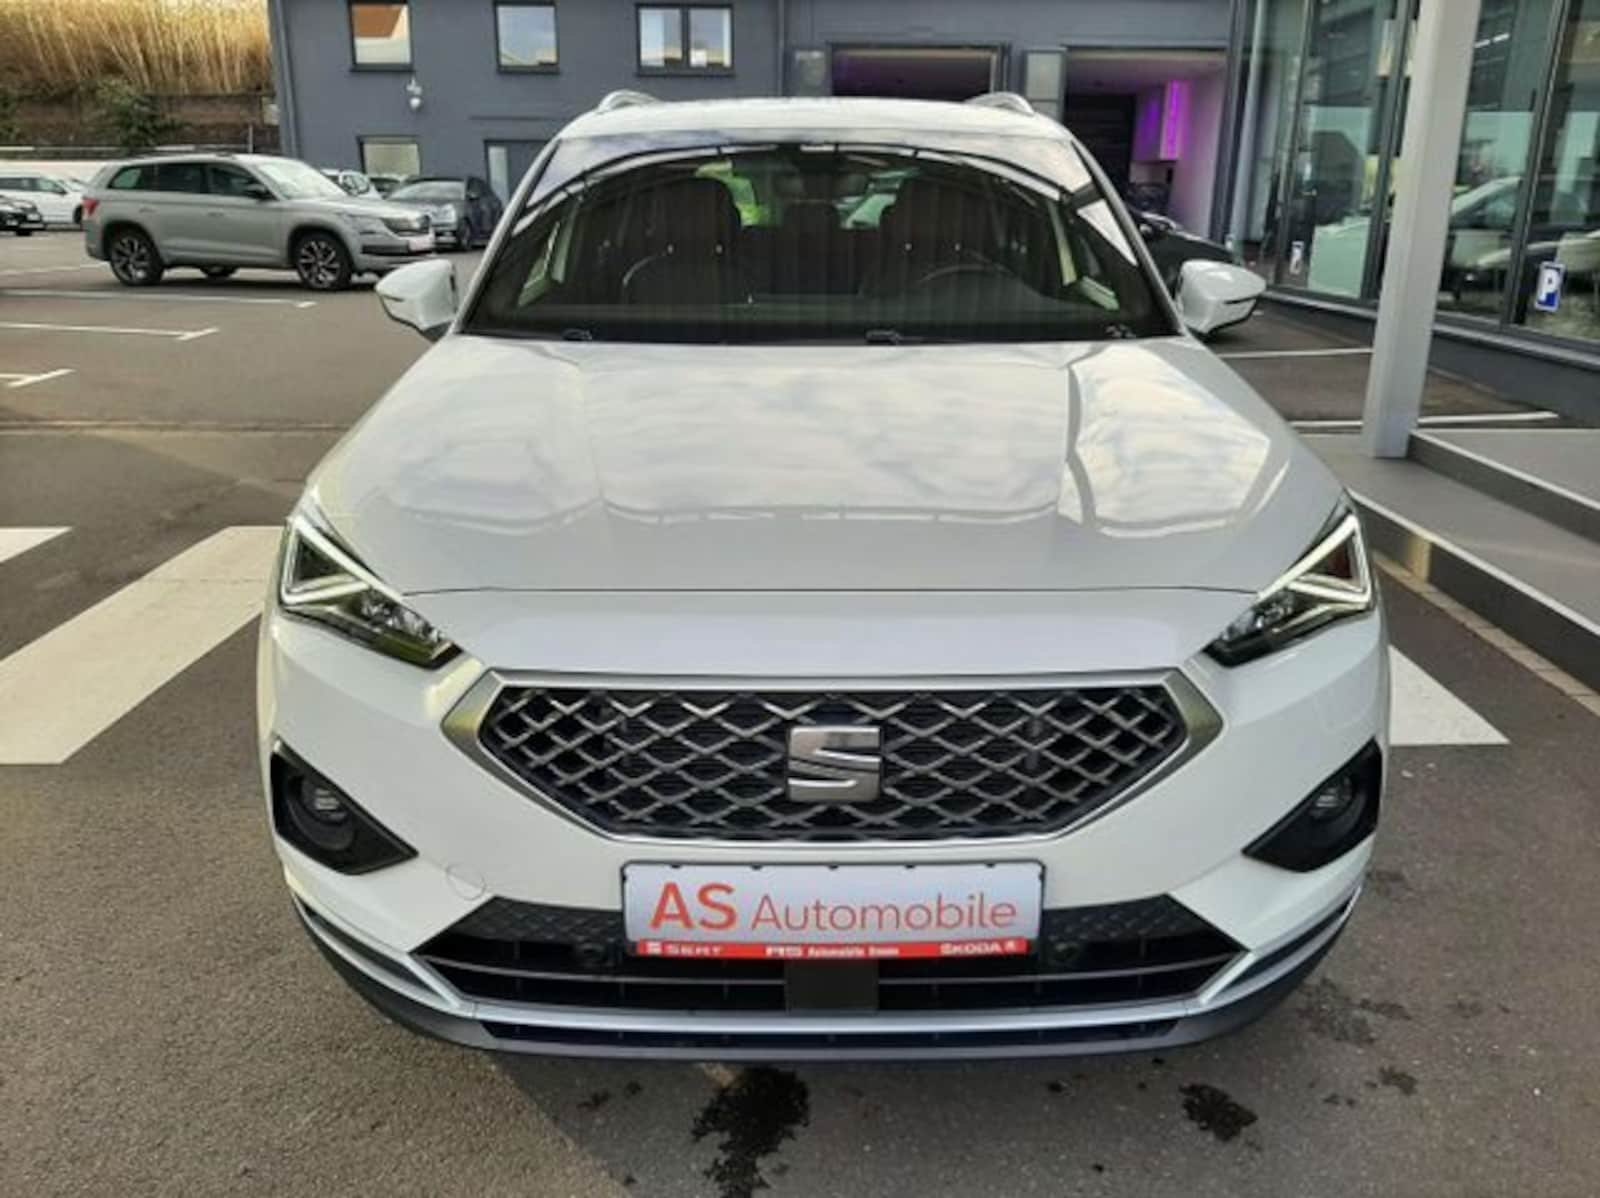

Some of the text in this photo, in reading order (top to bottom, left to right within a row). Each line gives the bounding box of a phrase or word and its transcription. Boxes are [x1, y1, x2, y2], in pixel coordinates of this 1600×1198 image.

[1539, 269, 1561, 302] P
[650, 881, 1017, 931] AS Automobile
